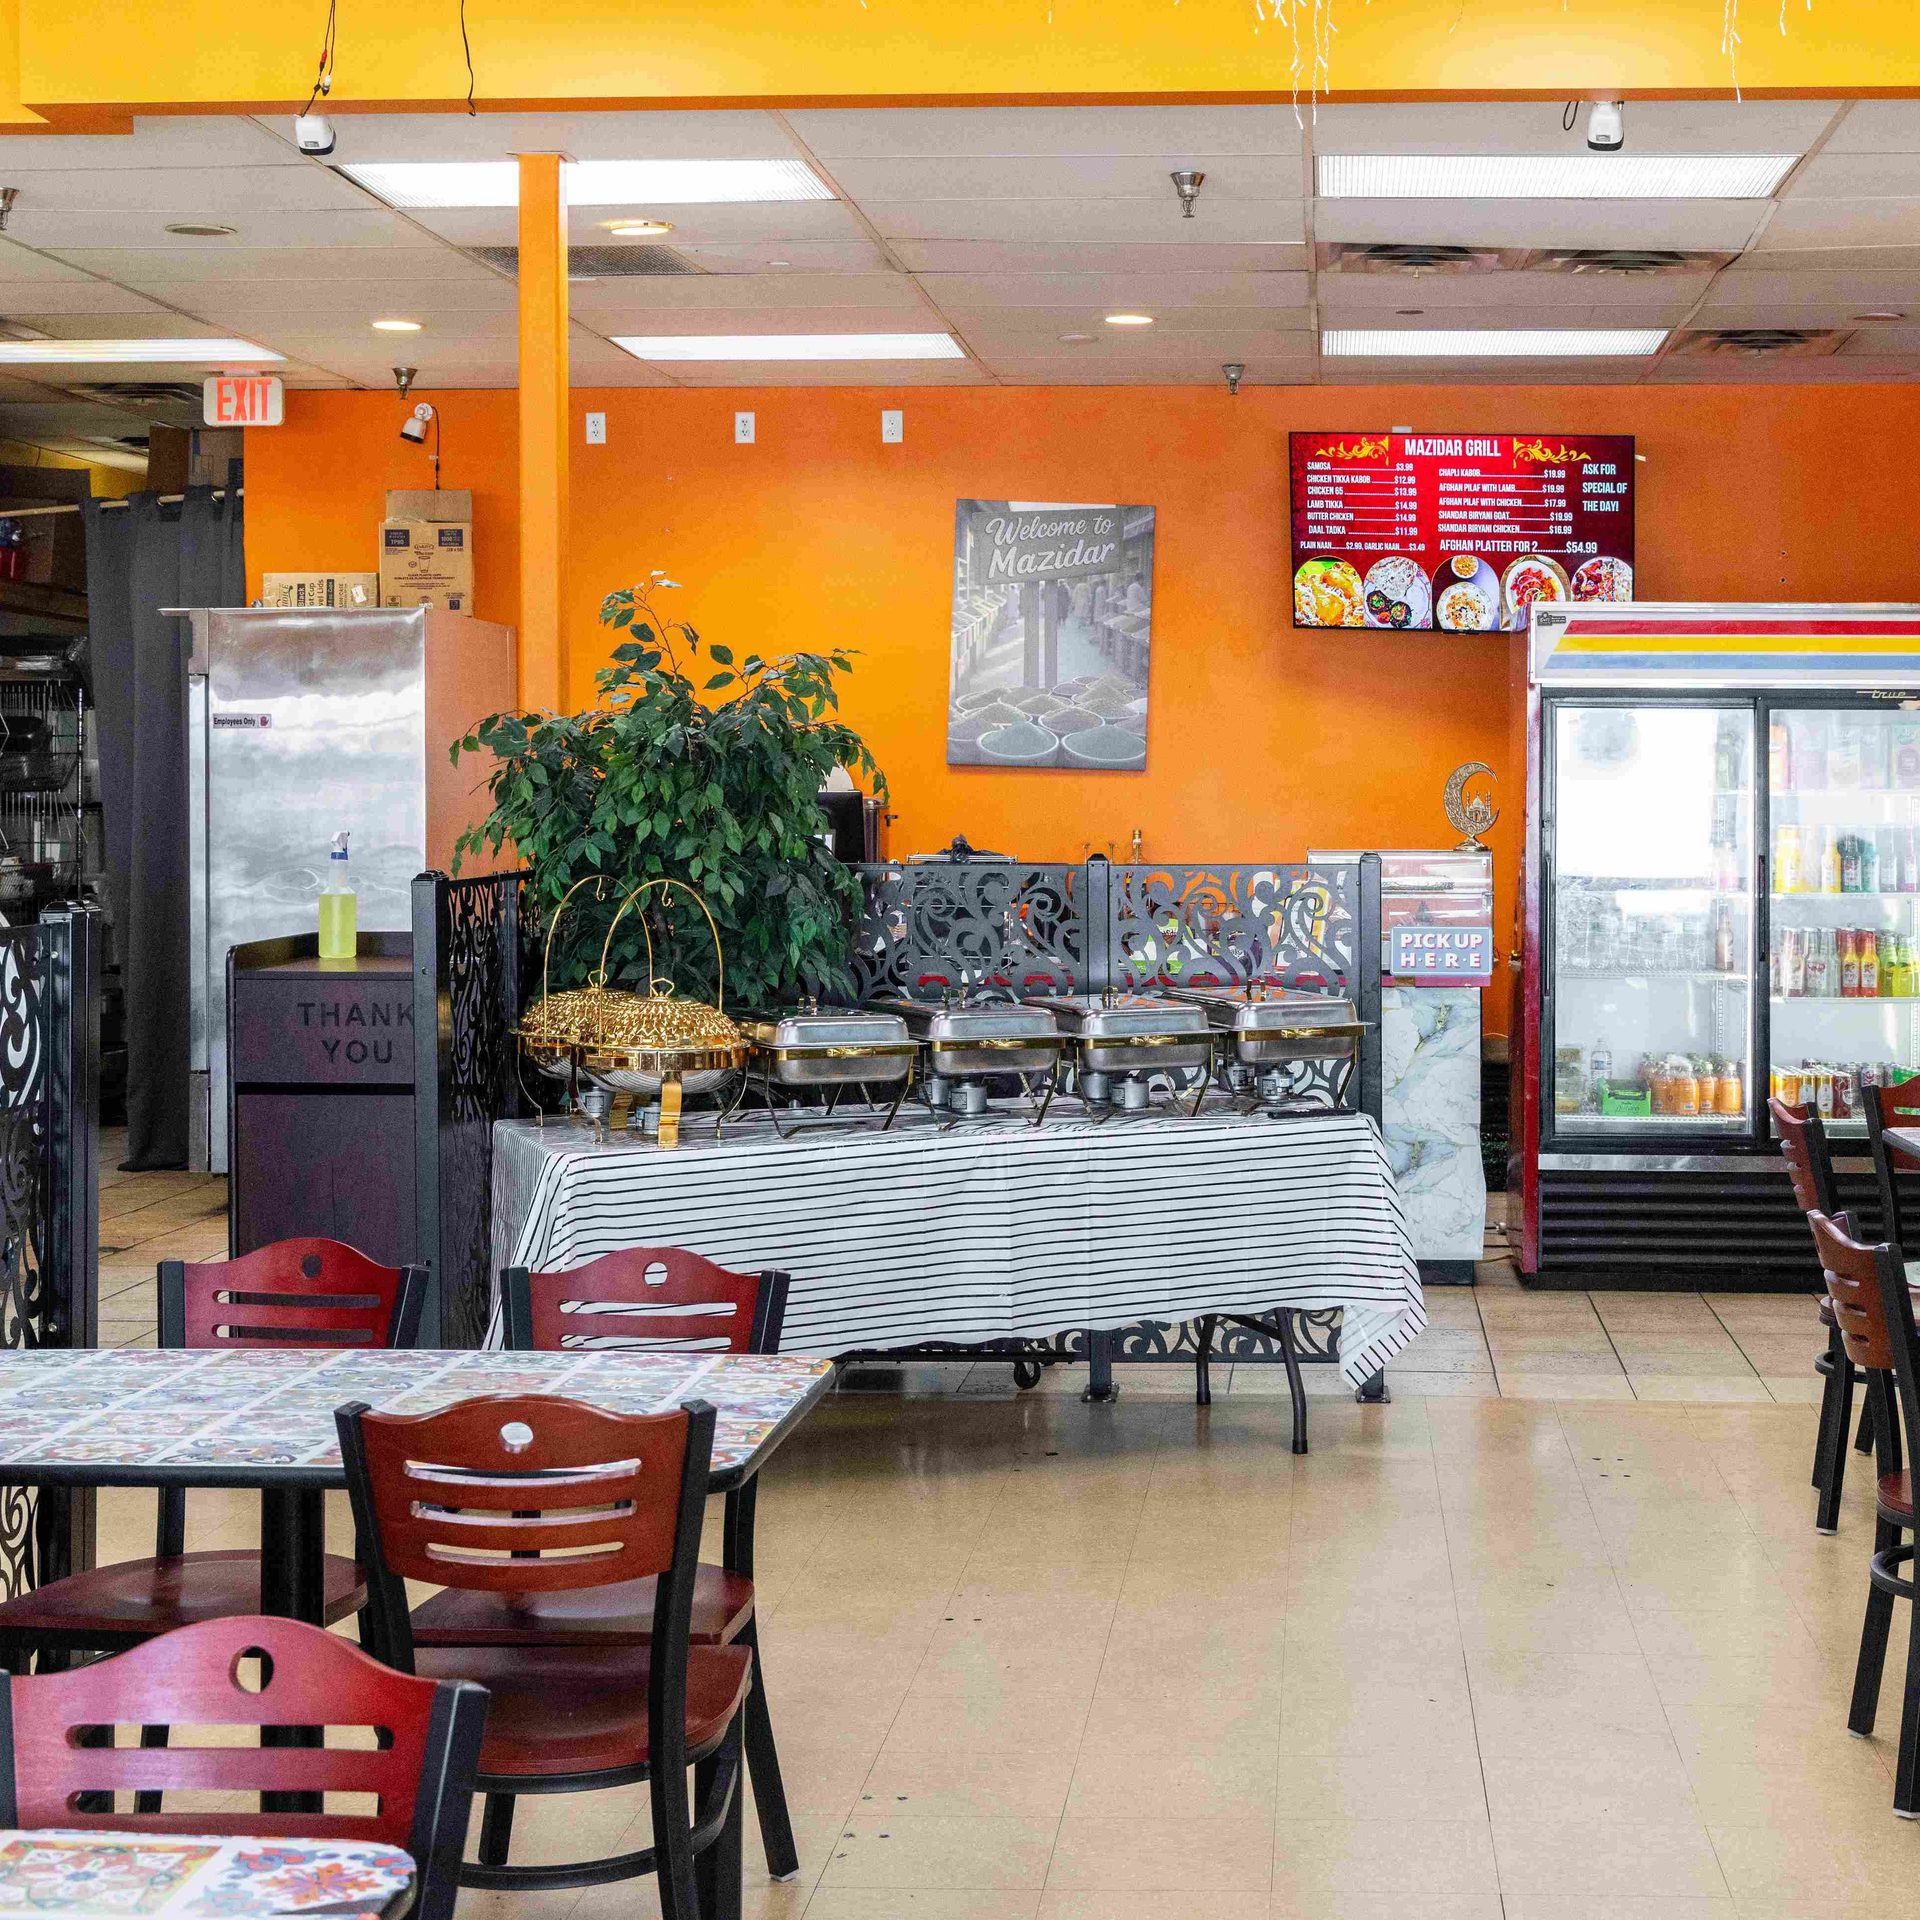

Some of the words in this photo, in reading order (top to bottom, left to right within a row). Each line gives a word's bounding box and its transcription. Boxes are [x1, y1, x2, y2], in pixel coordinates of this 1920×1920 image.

[216, 377, 272, 422] EXIT
[1405, 439, 1462, 456] MAZIDAR
[1466, 439, 1501, 457] GRILL
[1307, 462, 1331, 470] SAMOSA
[1396, 463, 1414, 471] $3.99
[1582, 464, 1599, 475] ASK
[1600, 464, 1616, 475] FOR
[1438, 468, 1460, 476] CHAPLI
[1460, 468, 1480, 476] KABOB
[1544, 470, 1566, 478] $19.99
[1306, 474, 1332, 482] CHICKEN
[1332, 475, 1350, 484] TIKKA
[1350, 476, 1370, 484] KABOB
[1394, 476, 1416, 484] $12.99
[1308, 486, 1334, 494] CHICKEN
[1335, 487, 1344, 495] 65
[1394, 488, 1417, 496] $13.99
[1438, 483, 1463, 492] AFGHAN
[1464, 484, 1480, 492] PILAF
[1482, 484, 1498, 492] WITH
[1498, 484, 1516, 492] LAMB
[1542, 484, 1564, 493] $19.99
[1582, 482, 1616, 494] SPECIAL
[1616, 483, 1628, 493] OF
[1307, 500, 1324, 508] LAMB
[1325, 500, 1344, 509] TIKKA
[1395, 502, 1417, 510] $14.99
[1438, 498, 1462, 506] AFGHAN
[1463, 498, 1480, 506] PILAF
[1480, 498, 1496, 506] WITH
[1496, 498, 1522, 506] CHICKEN
[1544, 499, 1566, 508] $17.99
[1582, 500, 1598, 512] THE
[1600, 501, 1619, 512] DAY!
[1307, 512, 1329, 520] BUTTER
[1330, 512, 1354, 521] CHICKEN
[1395, 514, 1416, 522] $14.99
[1438, 511, 1468, 520] SHANDAR
[1468, 511, 1493, 520] BIRYANI
[1494, 512, 1510, 520] GOAT
[1550, 512, 1573, 521] $19.99
[985, 516, 1087, 546] Welcome
[1092, 514, 1116, 535] to
[1308, 525, 1325, 534] DAAL
[1326, 526, 1346, 534] TADKA
[1395, 526, 1418, 536] $11.99
[1438, 524, 1467, 532] SHANDAR
[1468, 524, 1492, 533] BIRYANI
[1493, 524, 1520, 534] CHICKEN
[1549, 526, 1572, 534] $16.99
[1300, 541, 1316, 549] PLAIN
[1317, 541, 1332, 550] NAAN
[1364, 542, 1384, 550] GARLIC
[1384, 542, 1400, 551] NAAN
[1440, 540, 1474, 551] AFGHAN
[1476, 540, 1512, 552] PLATTER
[1514, 541, 1530, 552] FOR
[1532, 541, 1538, 552] 2
[1566, 542, 1598, 554] $54.99
[988, 539, 1116, 579] Mazidar
[214, 718, 242, 726] Employees
[244, 718, 256, 726] Only
[1400, 933, 1452, 949] PICK
[1454, 933, 1484, 949] UP
[297, 1002, 414, 1027] THANK
[321, 1038, 393, 1064] YOU
